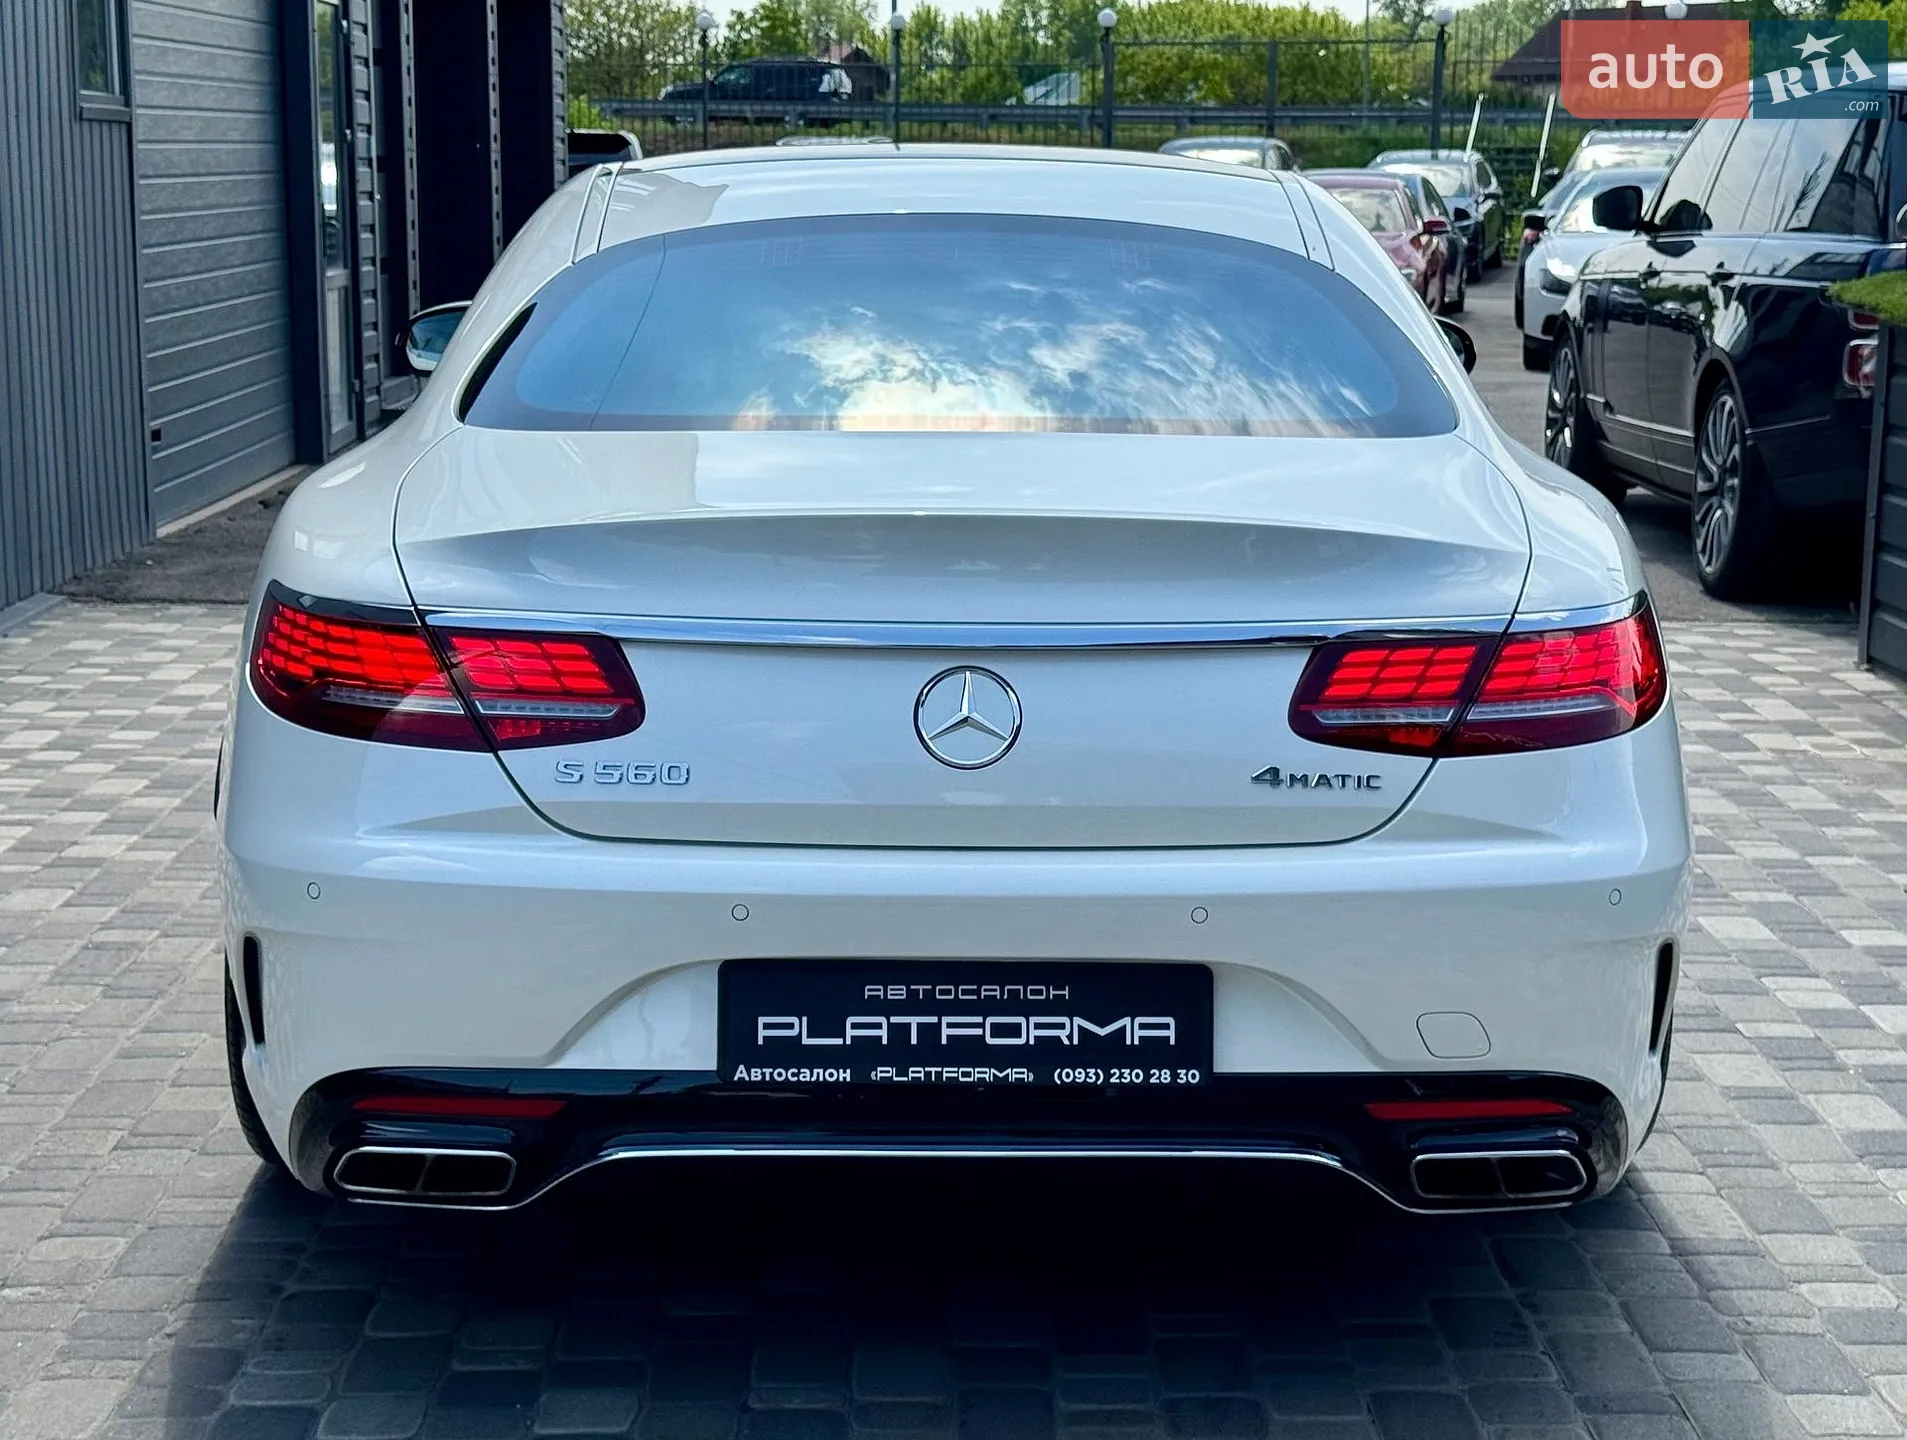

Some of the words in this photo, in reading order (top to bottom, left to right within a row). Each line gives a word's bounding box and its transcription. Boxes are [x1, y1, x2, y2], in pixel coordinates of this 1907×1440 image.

[555, 761, 584, 783] S
[594, 761, 690, 785] 560
[1251, 765, 1382, 789] 4MATIC
[864, 985, 1069, 1000] АВТОСАЛОН
[757, 1016, 1176, 1045] PLATFORMA
[733, 1064, 851, 1082] Автосалон
[1053, 1068, 1104, 1085] (093)
[1110, 1069, 1145, 1084] 230
[1149, 1069, 1172, 1084] 28
[1176, 1069, 1200, 1084] 30
